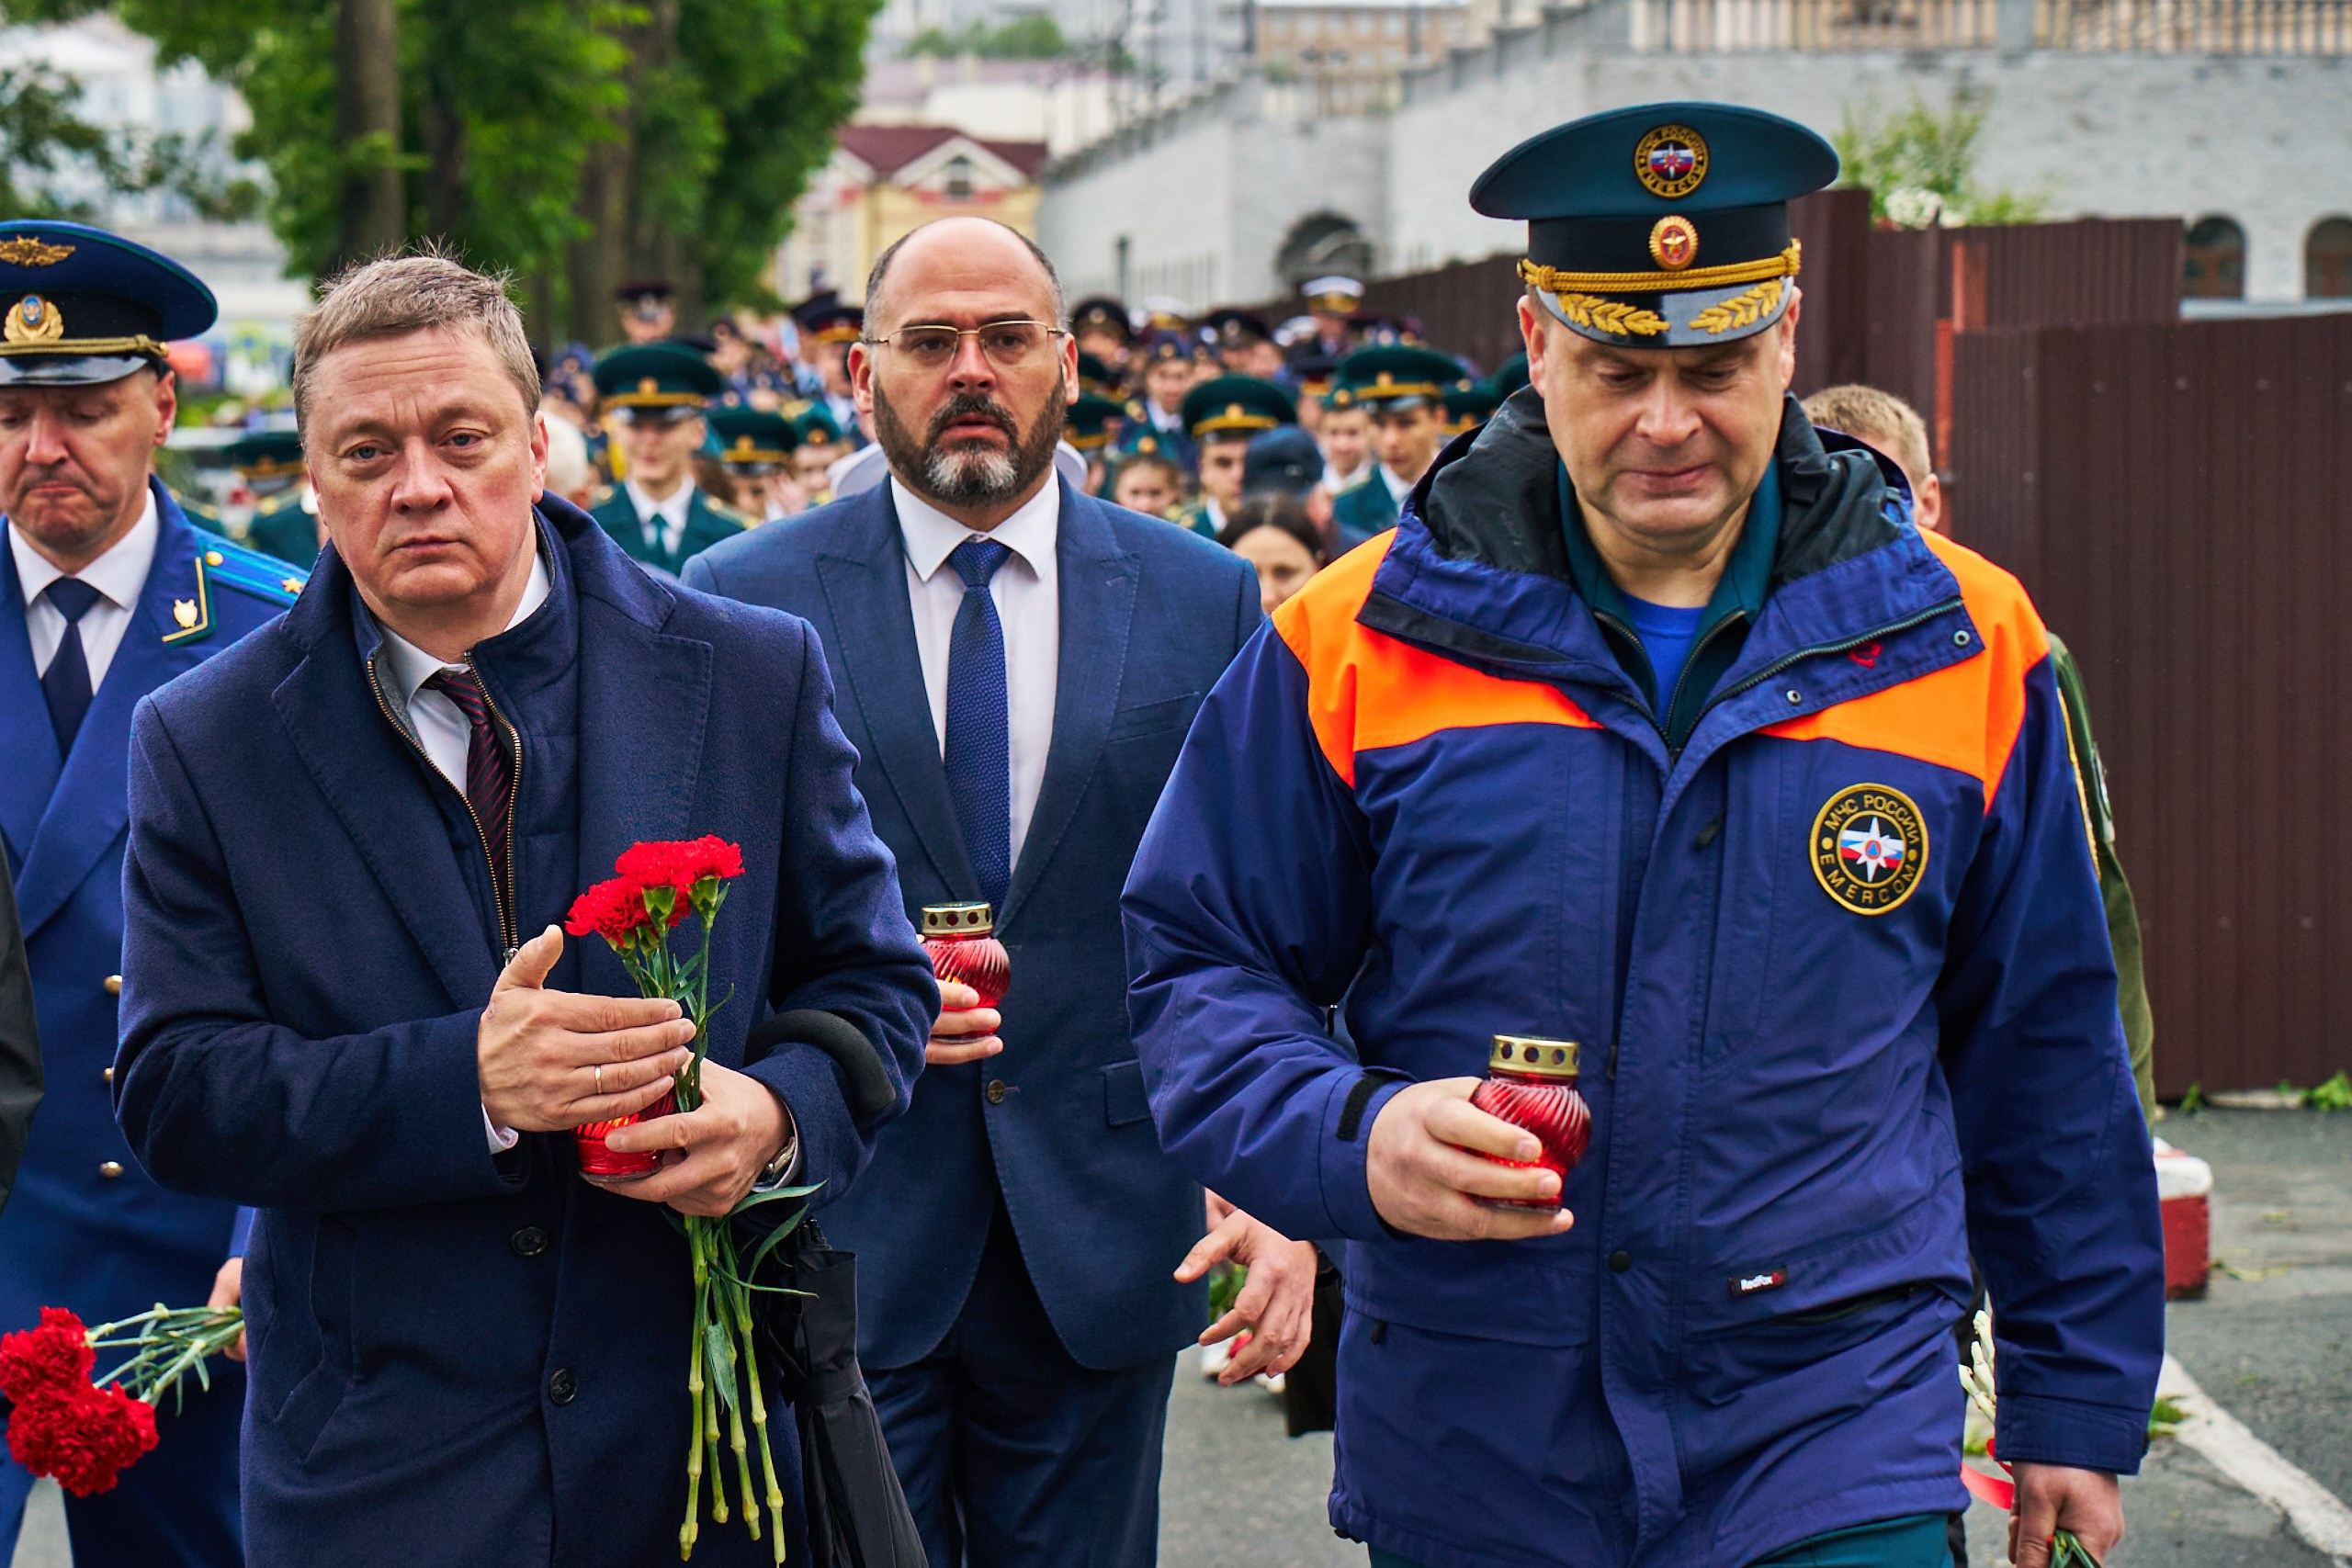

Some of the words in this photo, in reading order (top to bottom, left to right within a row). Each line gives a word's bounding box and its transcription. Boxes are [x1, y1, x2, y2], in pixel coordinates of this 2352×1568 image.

[1825, 798, 1860, 830] МЧС
[1863, 795, 1919, 844] РОССИИ
[1820, 853, 1916, 904] EMERCOM
